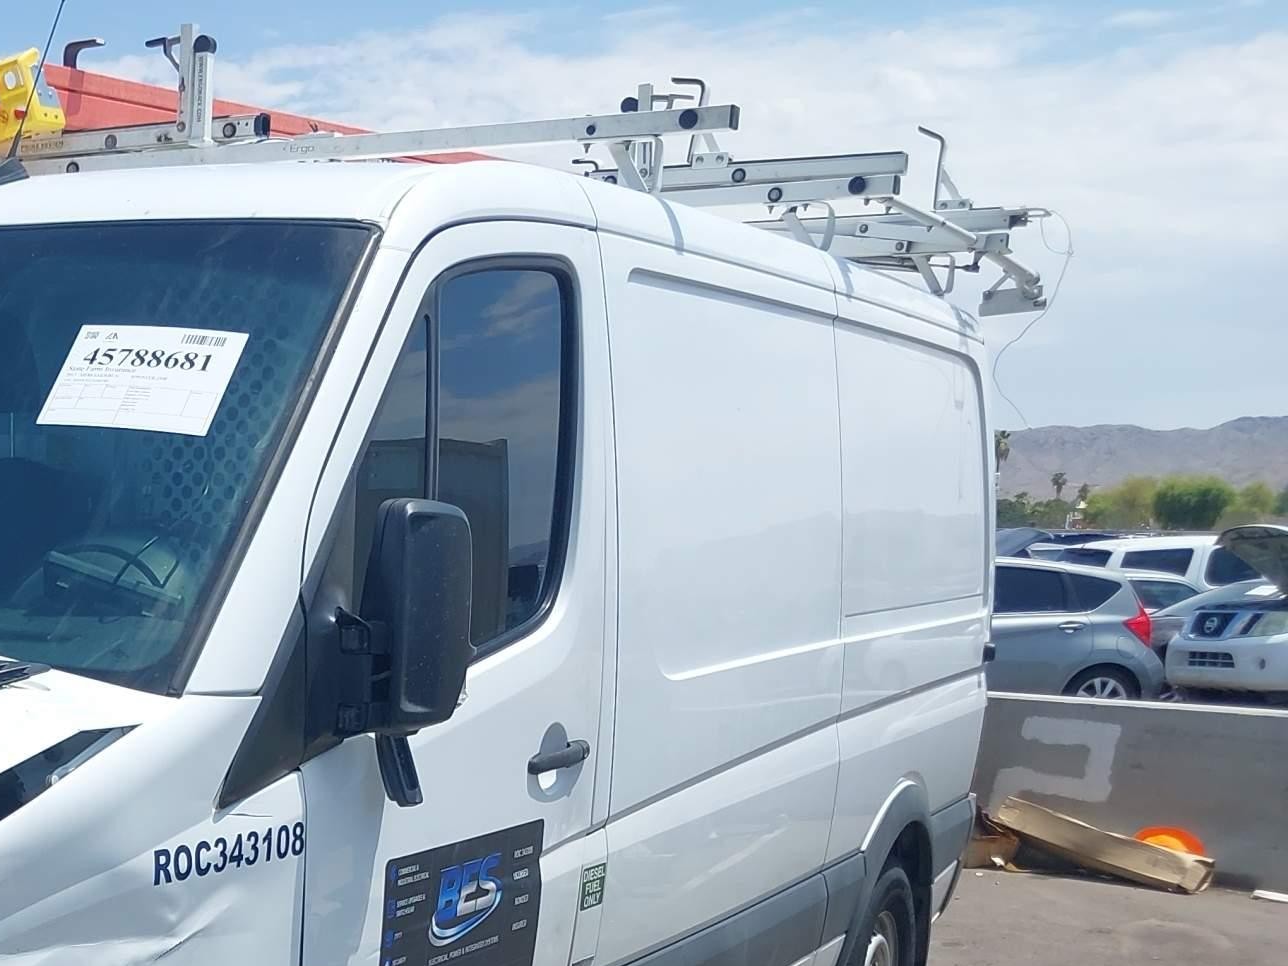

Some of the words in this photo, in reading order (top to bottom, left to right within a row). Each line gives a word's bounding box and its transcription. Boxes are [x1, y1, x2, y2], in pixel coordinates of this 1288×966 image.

[83, 347, 213, 372] 45788681
[153, 822, 305, 886] ROC343108
[583, 865, 605, 882] DIESEL
[436, 853, 503, 922] BES
[585, 879, 601, 895] FUEL
[583, 891, 601, 907] ONLY
